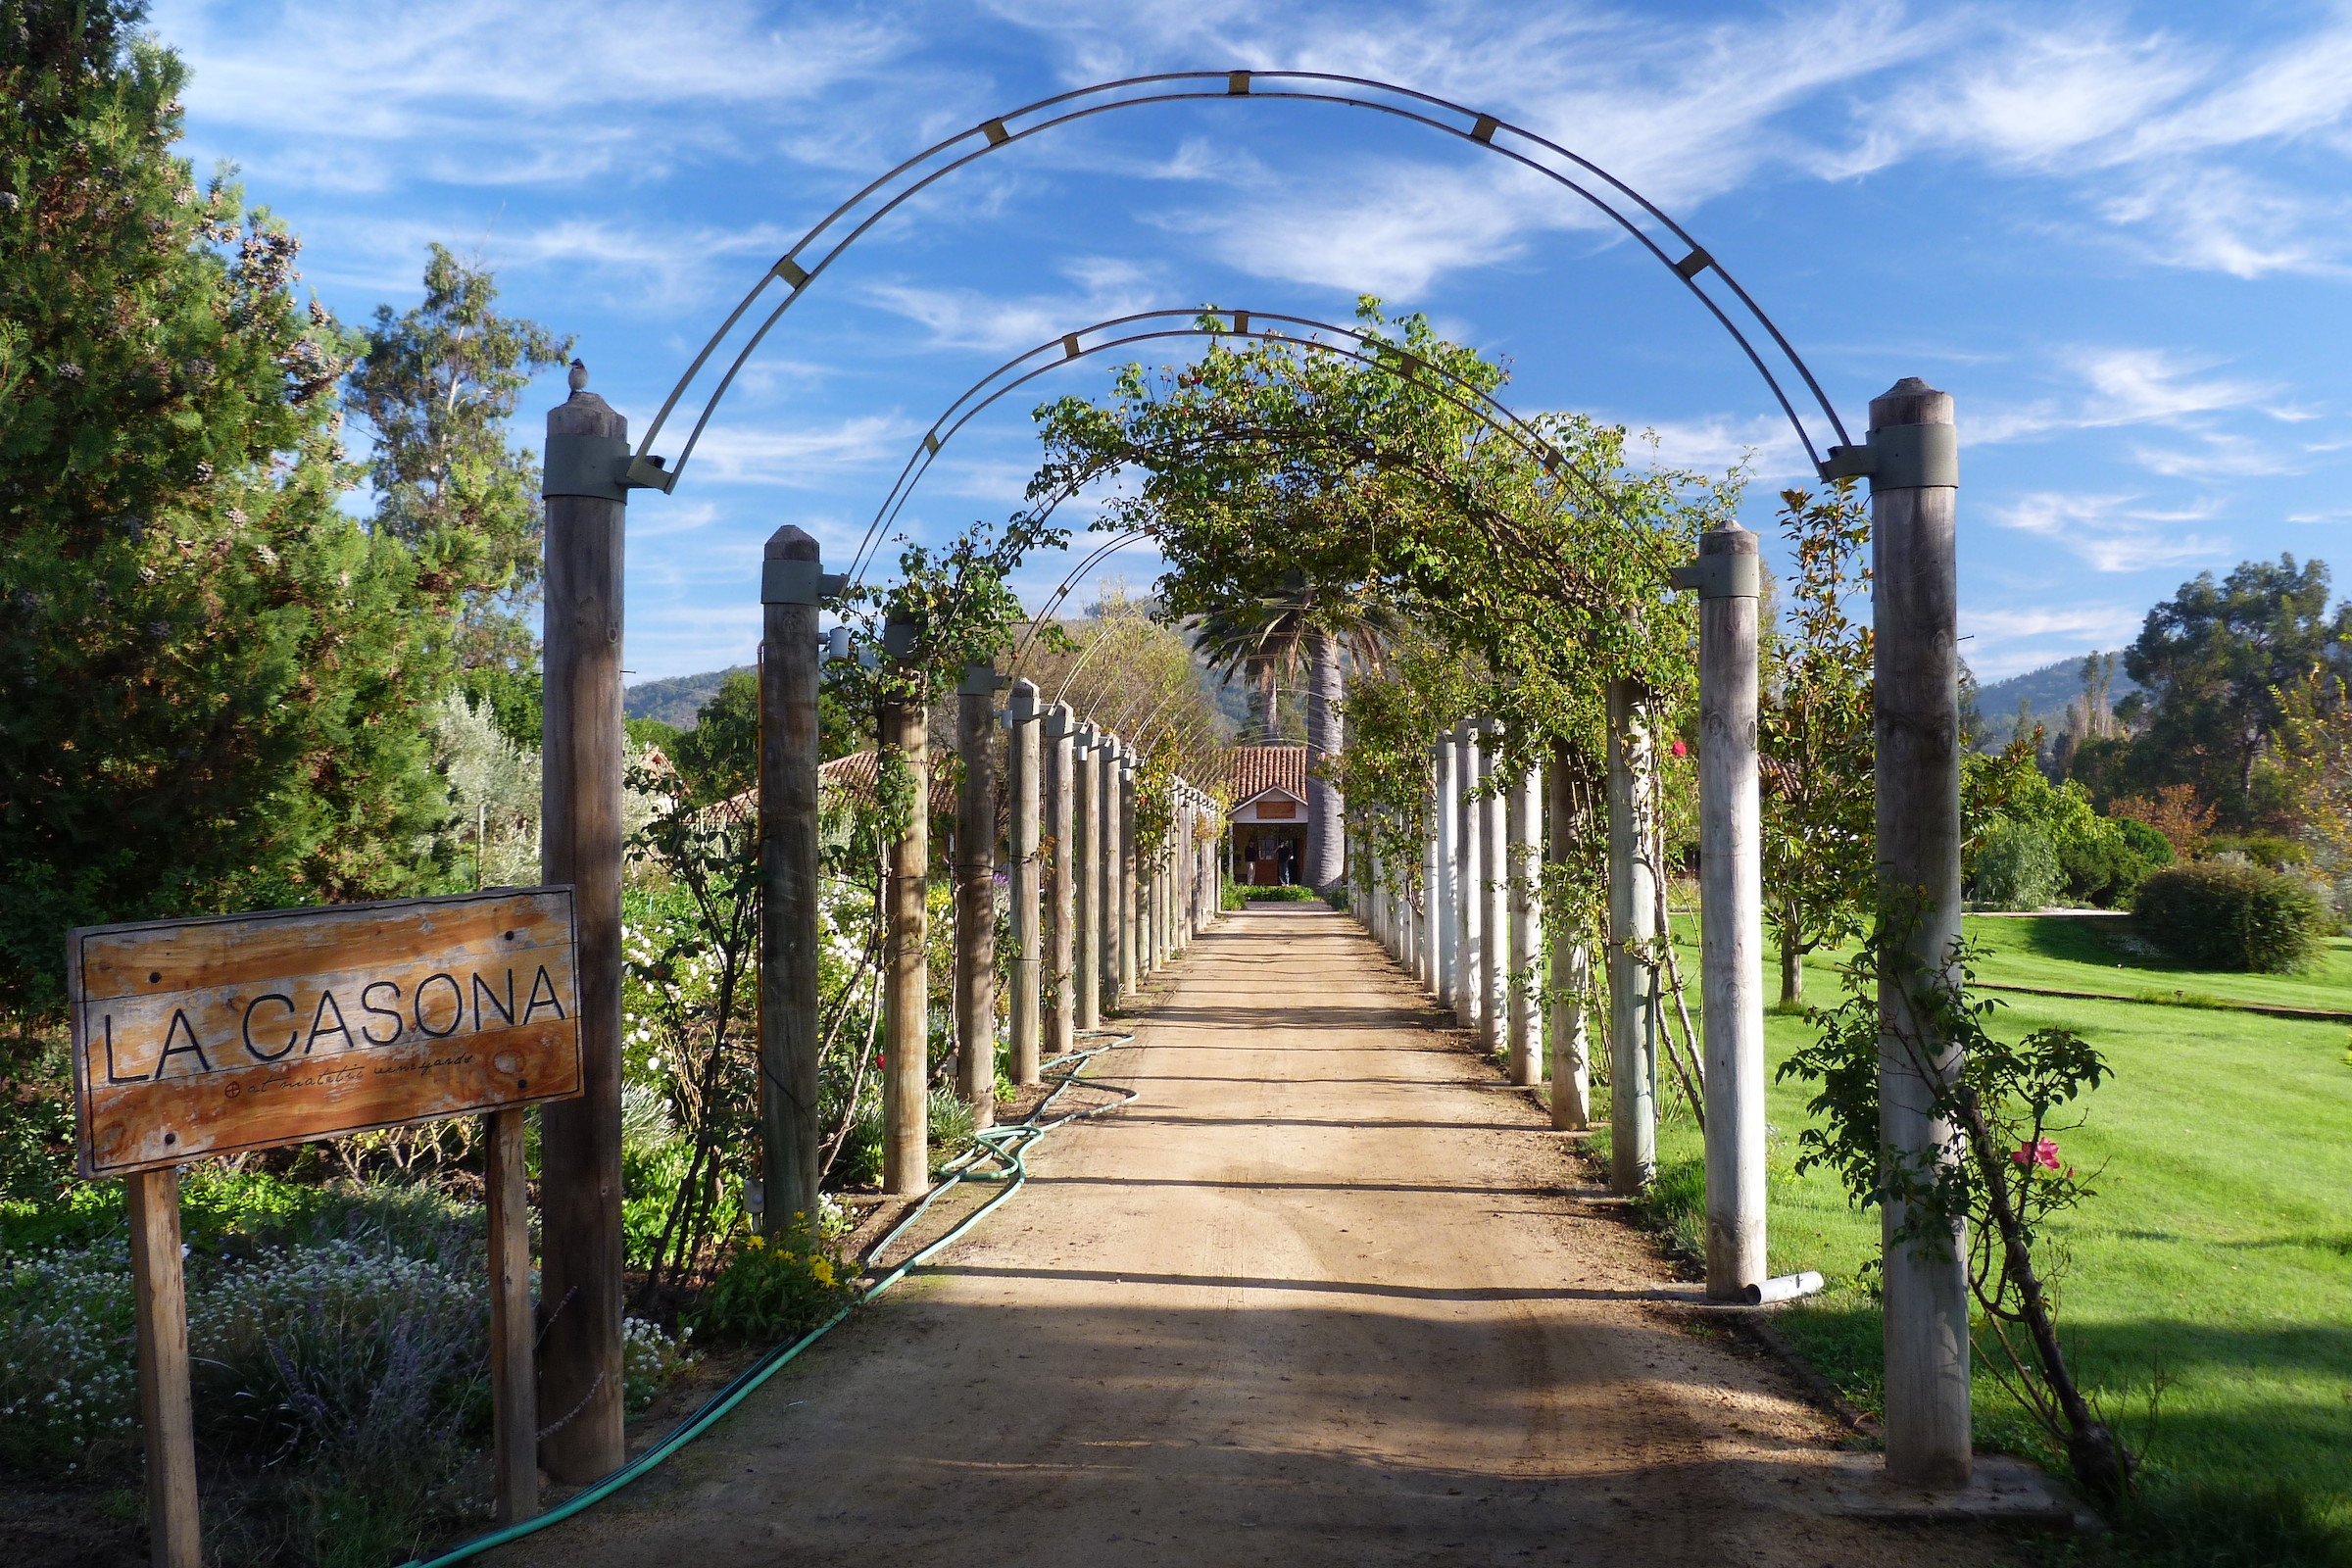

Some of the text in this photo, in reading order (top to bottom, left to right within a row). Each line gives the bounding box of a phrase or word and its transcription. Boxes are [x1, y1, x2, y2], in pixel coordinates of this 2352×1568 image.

[105, 964, 565, 1085] LA CASONA
[247, 1075, 290, 1094] at
